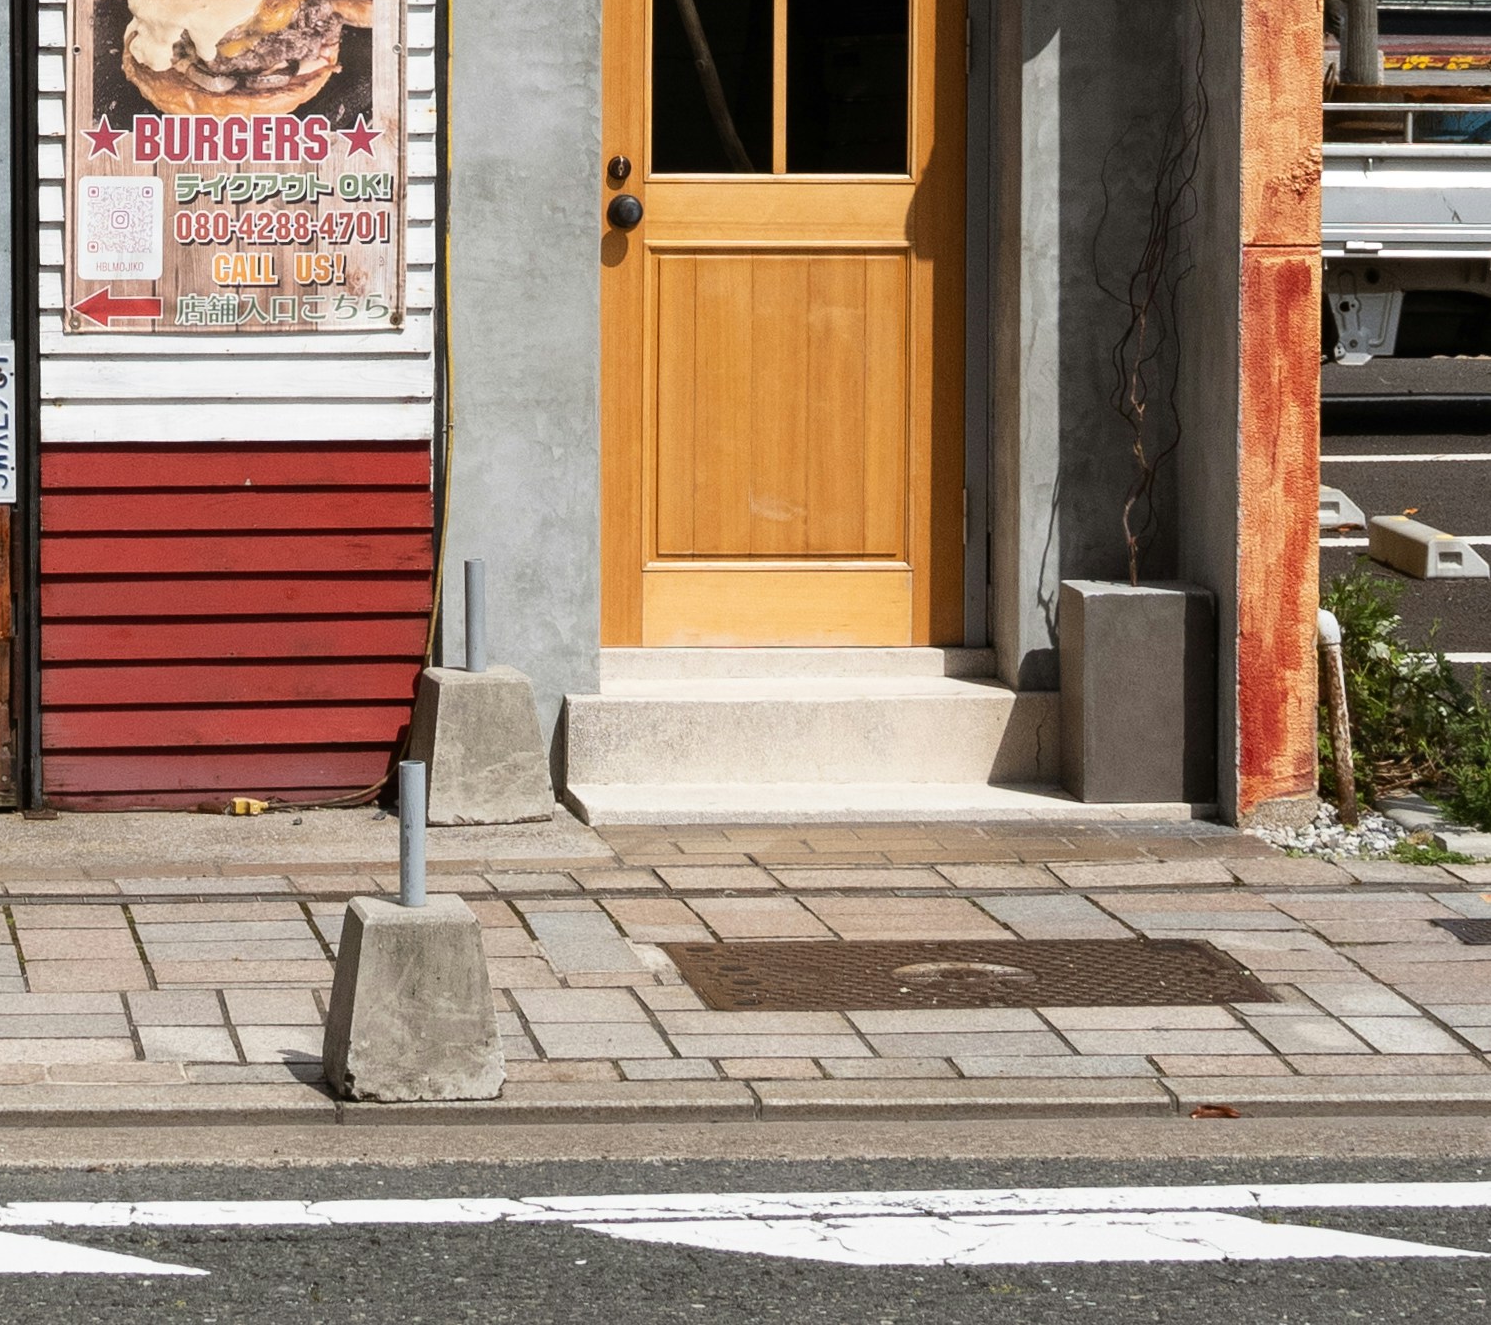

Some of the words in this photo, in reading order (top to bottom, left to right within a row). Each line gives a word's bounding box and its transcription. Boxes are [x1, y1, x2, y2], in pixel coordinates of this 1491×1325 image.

[132, 114, 331, 164] BURGERS
[174, 172, 331, 202] テイクアウト
[338, 172, 393, 201] OK!
[174, 209, 390, 243] 080-4288-4701
[212, 252, 278, 285] CALL
[294, 252, 347, 285] US!
[174, 293, 391, 326] 店舗入口こちら
